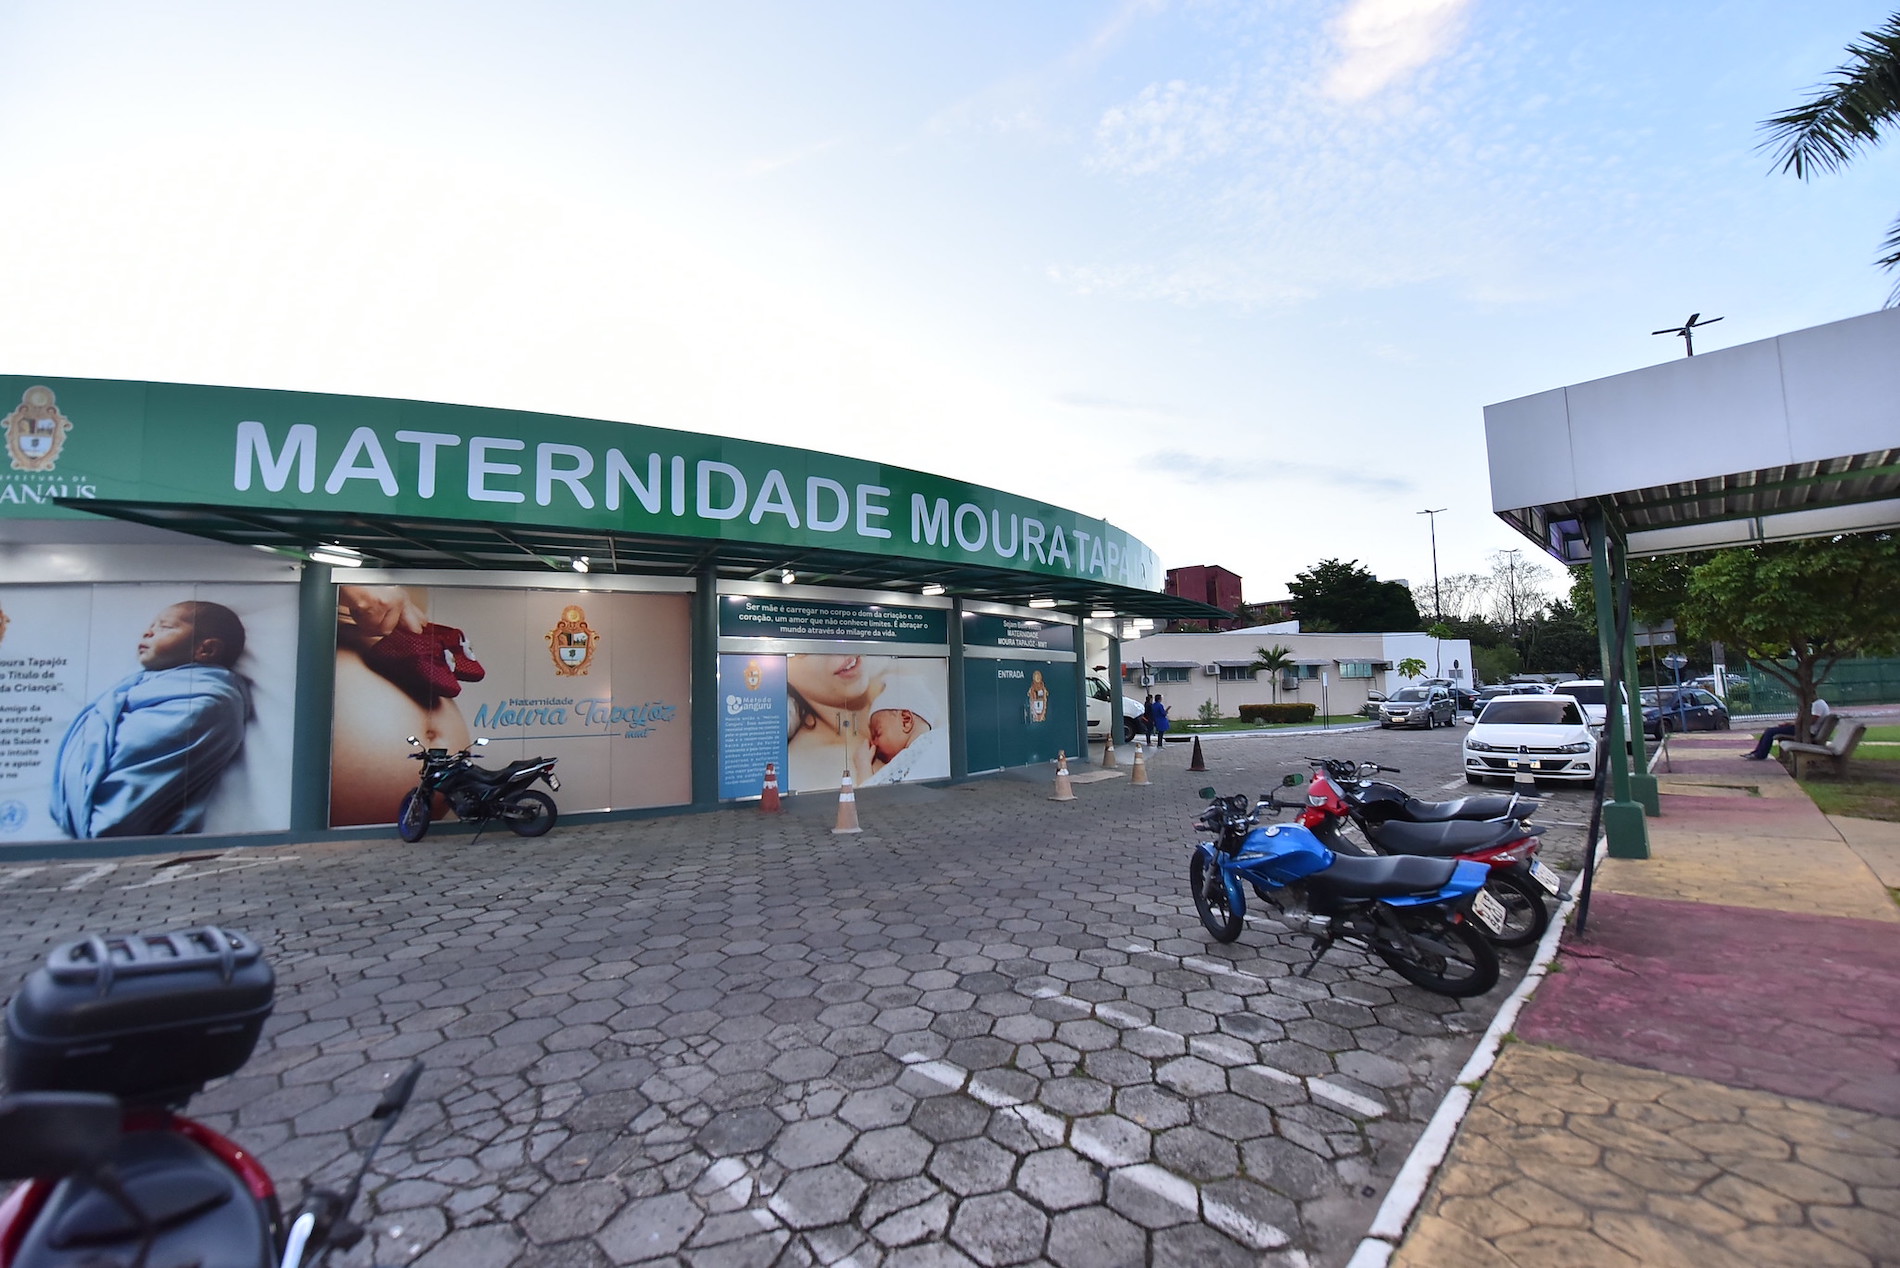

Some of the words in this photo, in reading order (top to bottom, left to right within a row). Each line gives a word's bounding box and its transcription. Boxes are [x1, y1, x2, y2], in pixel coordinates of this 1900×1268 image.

[234, 420, 892, 539] MATERNIDADE
[911, 493, 1071, 569] MOURA
[745, 602, 760, 611] Ser
[761, 603, 779, 612] mãe
[786, 606, 818, 616] carregar
[830, 609, 851, 617] corpo
[883, 612, 907, 620] criação
[810, 618, 823, 626] que
[825, 617, 838, 625] não
[839, 619, 868, 627] conhece
[869, 620, 892, 628] limites.
[894, 620, 898, 628] É
[899, 621, 922, 630] abraçar
[780, 626, 806, 634] mundo
[807, 627, 834, 635] através
[836, 627, 845, 635] do
[846, 629, 872, 637] milagre
[1007, 630, 1039, 639] MATERNIDADE
[997, 637, 1015, 646] MOURA
[9, 670, 39, 679] Título
[41, 670, 55, 679] de
[998, 669, 1025, 679] ENTRADA
[509, 696, 574, 706] Maternidade
[474, 700, 567, 729] Moura
